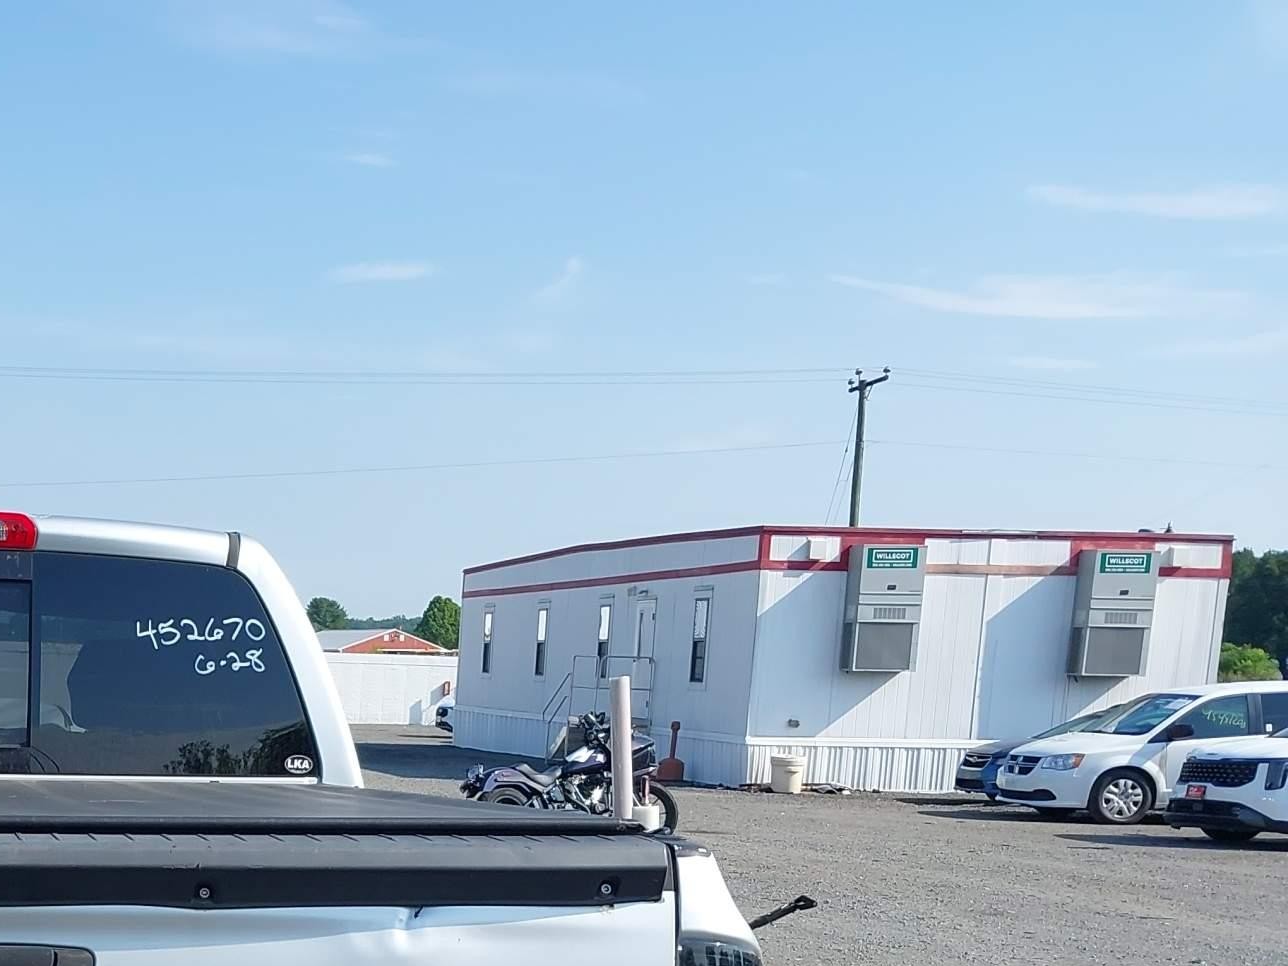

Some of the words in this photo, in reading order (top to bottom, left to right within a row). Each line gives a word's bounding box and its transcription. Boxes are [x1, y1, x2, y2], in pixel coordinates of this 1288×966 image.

[1109, 557, 1144, 565] WILLSCOT
[136, 617, 266, 650] 452670
[287, 758, 310, 769] LKA
